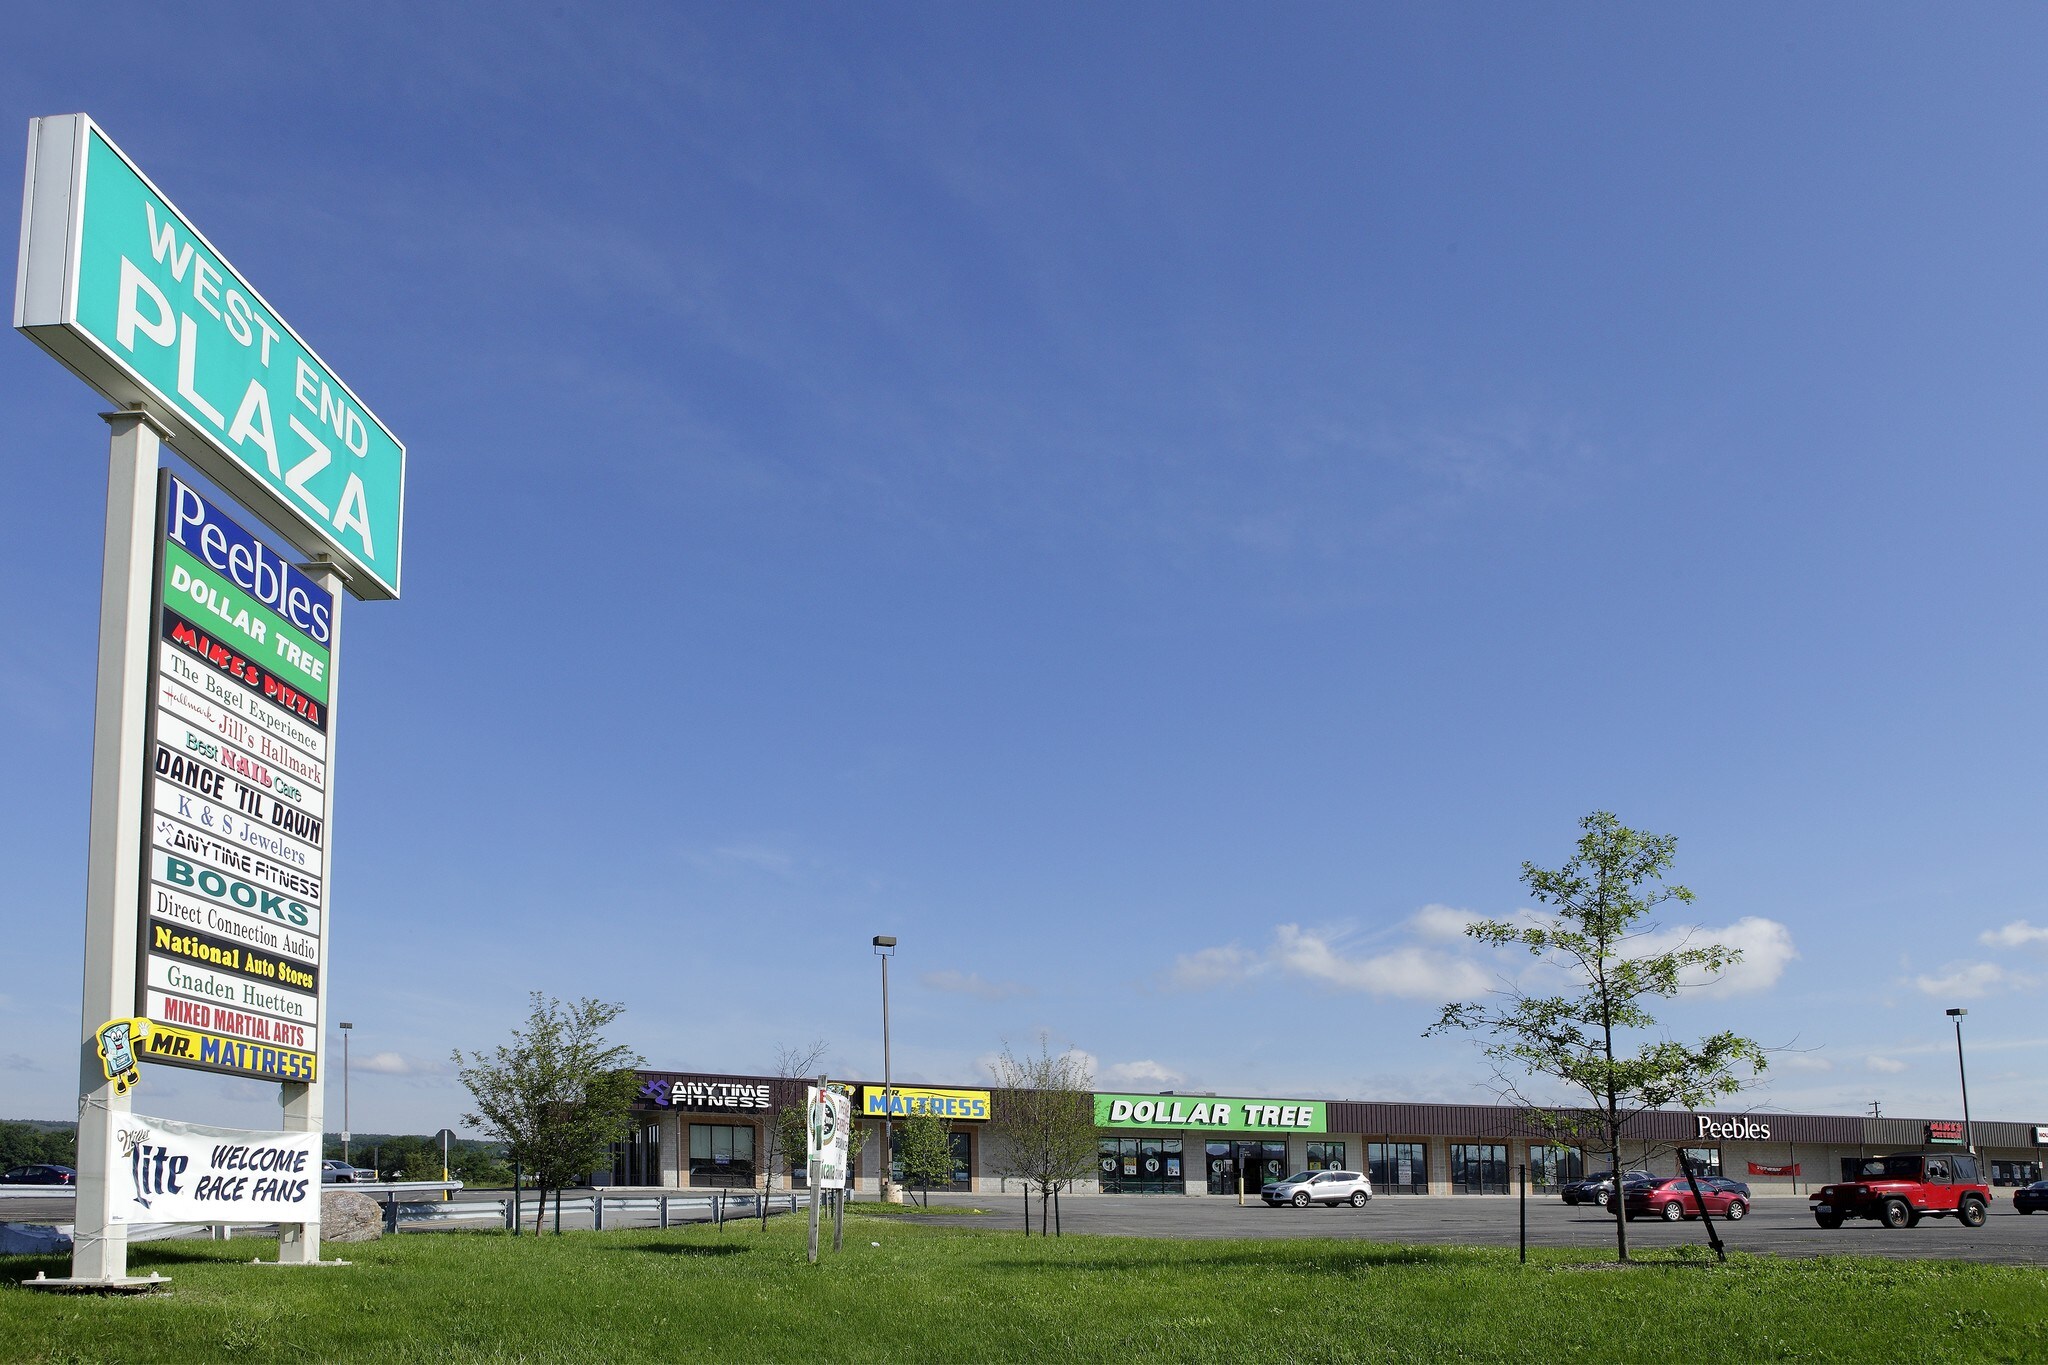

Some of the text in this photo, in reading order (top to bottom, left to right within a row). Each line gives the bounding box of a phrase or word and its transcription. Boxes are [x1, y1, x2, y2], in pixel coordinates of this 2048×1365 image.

[145, 200, 369, 459] WEST END
[116, 254, 375, 560] PLAZA
[169, 476, 329, 643] Peebles
[171, 564, 326, 682] DOLLAR TREE
[171, 654, 317, 751] The Bagel Experience
[172, 622, 319, 725] MIKES PIZZA
[163, 685, 322, 785] Hallmark Jill's Hallmark
[186, 730, 302, 803] Best NAIL Care
[156, 747, 321, 845] DANCE 'TIL DAWN
[178, 793, 305, 866] K & S Jewelers
[166, 856, 309, 927] BOOKS
[174, 829, 319, 900] ANYTIME FITNESS
[155, 925, 313, 989] National Auto Stores
[157, 890, 315, 960] Direct Connection Audio
[164, 997, 304, 1047] MIXED MARTIAL ARTS
[167, 965, 303, 1017] Gnaden Huetten
[151, 1033, 313, 1081] MR. MATTRESS
[671, 1081, 770, 1098] ANYTIME
[672, 1094, 770, 1108] FITNESS
[869, 1095, 985, 1117] MATTRESS
[1110, 1099, 1314, 1128] DOLLAR TREE
[1697, 1115, 1771, 1140] Peebles
[194, 1175, 309, 1203] RACE FANS
[210, 1144, 309, 1173] WELCOME
